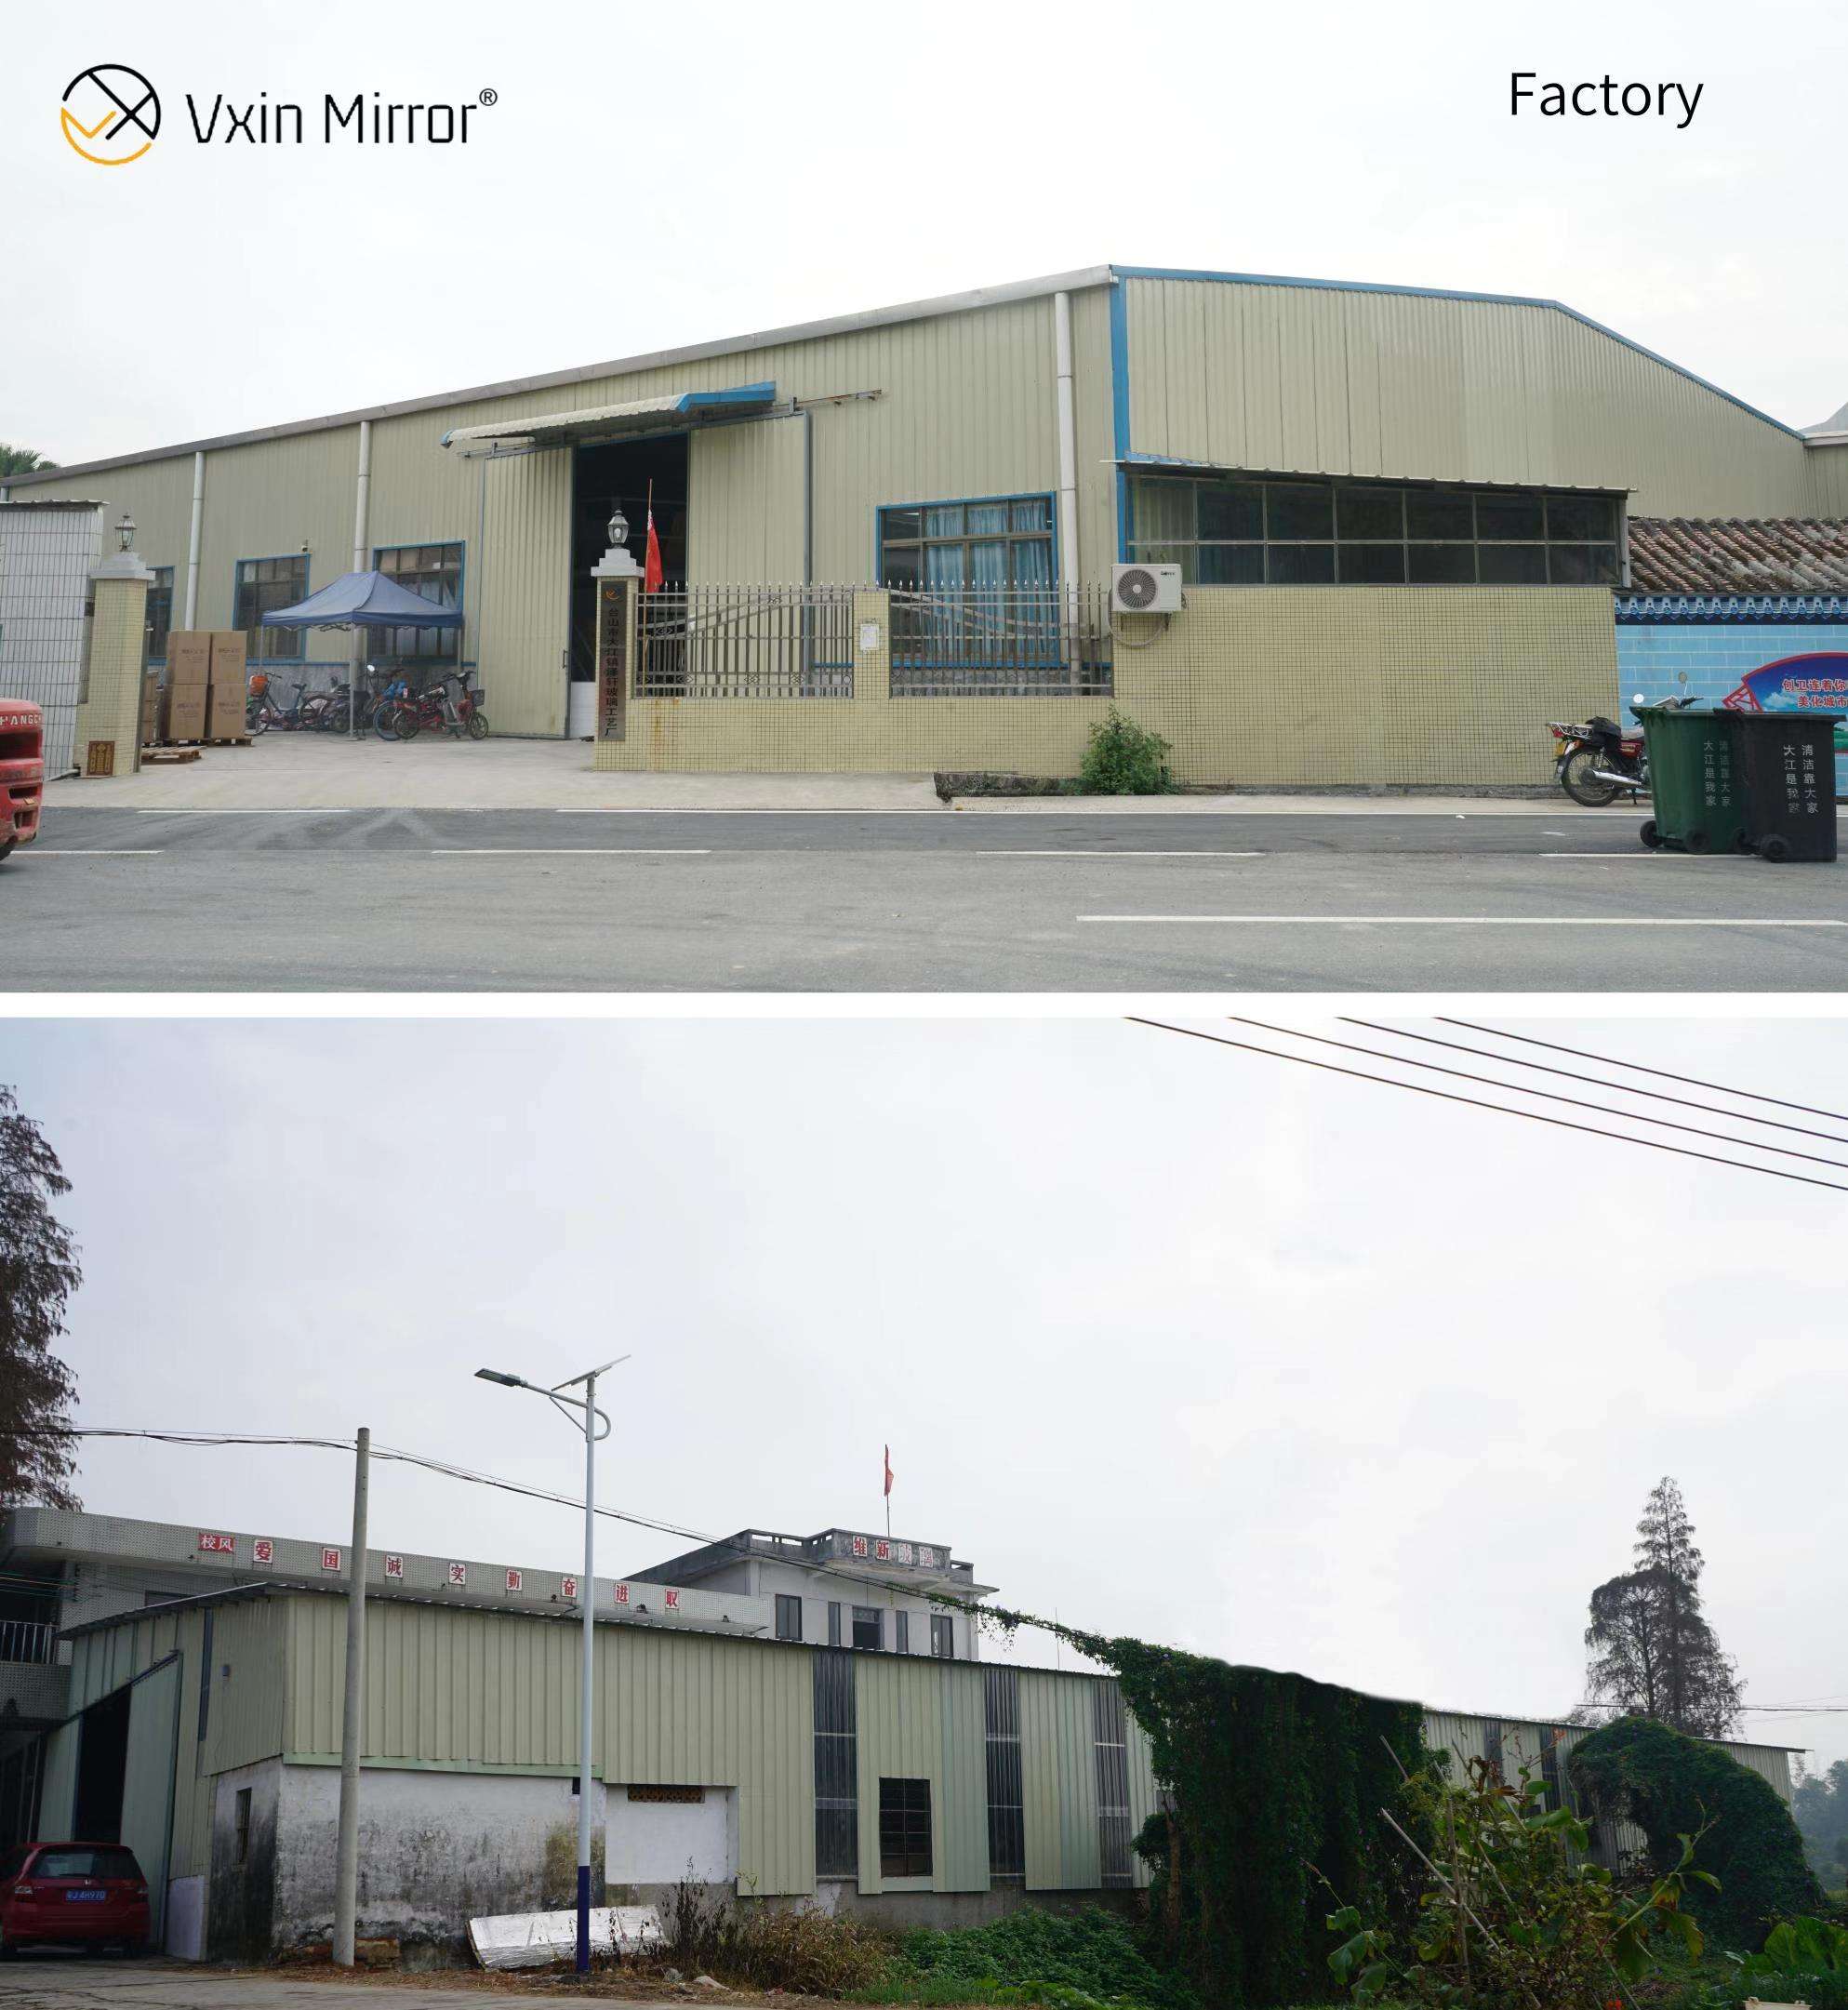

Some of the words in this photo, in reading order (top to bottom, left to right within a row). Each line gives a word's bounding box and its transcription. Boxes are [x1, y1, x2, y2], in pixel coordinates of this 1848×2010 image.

[1704, 740, 1717, 807] 大江是我家
[1783, 744, 1801, 813] 大江是我家
[1801, 744, 1819, 814] 清洁靠大家
[200, 1534, 233, 1552] 校风
